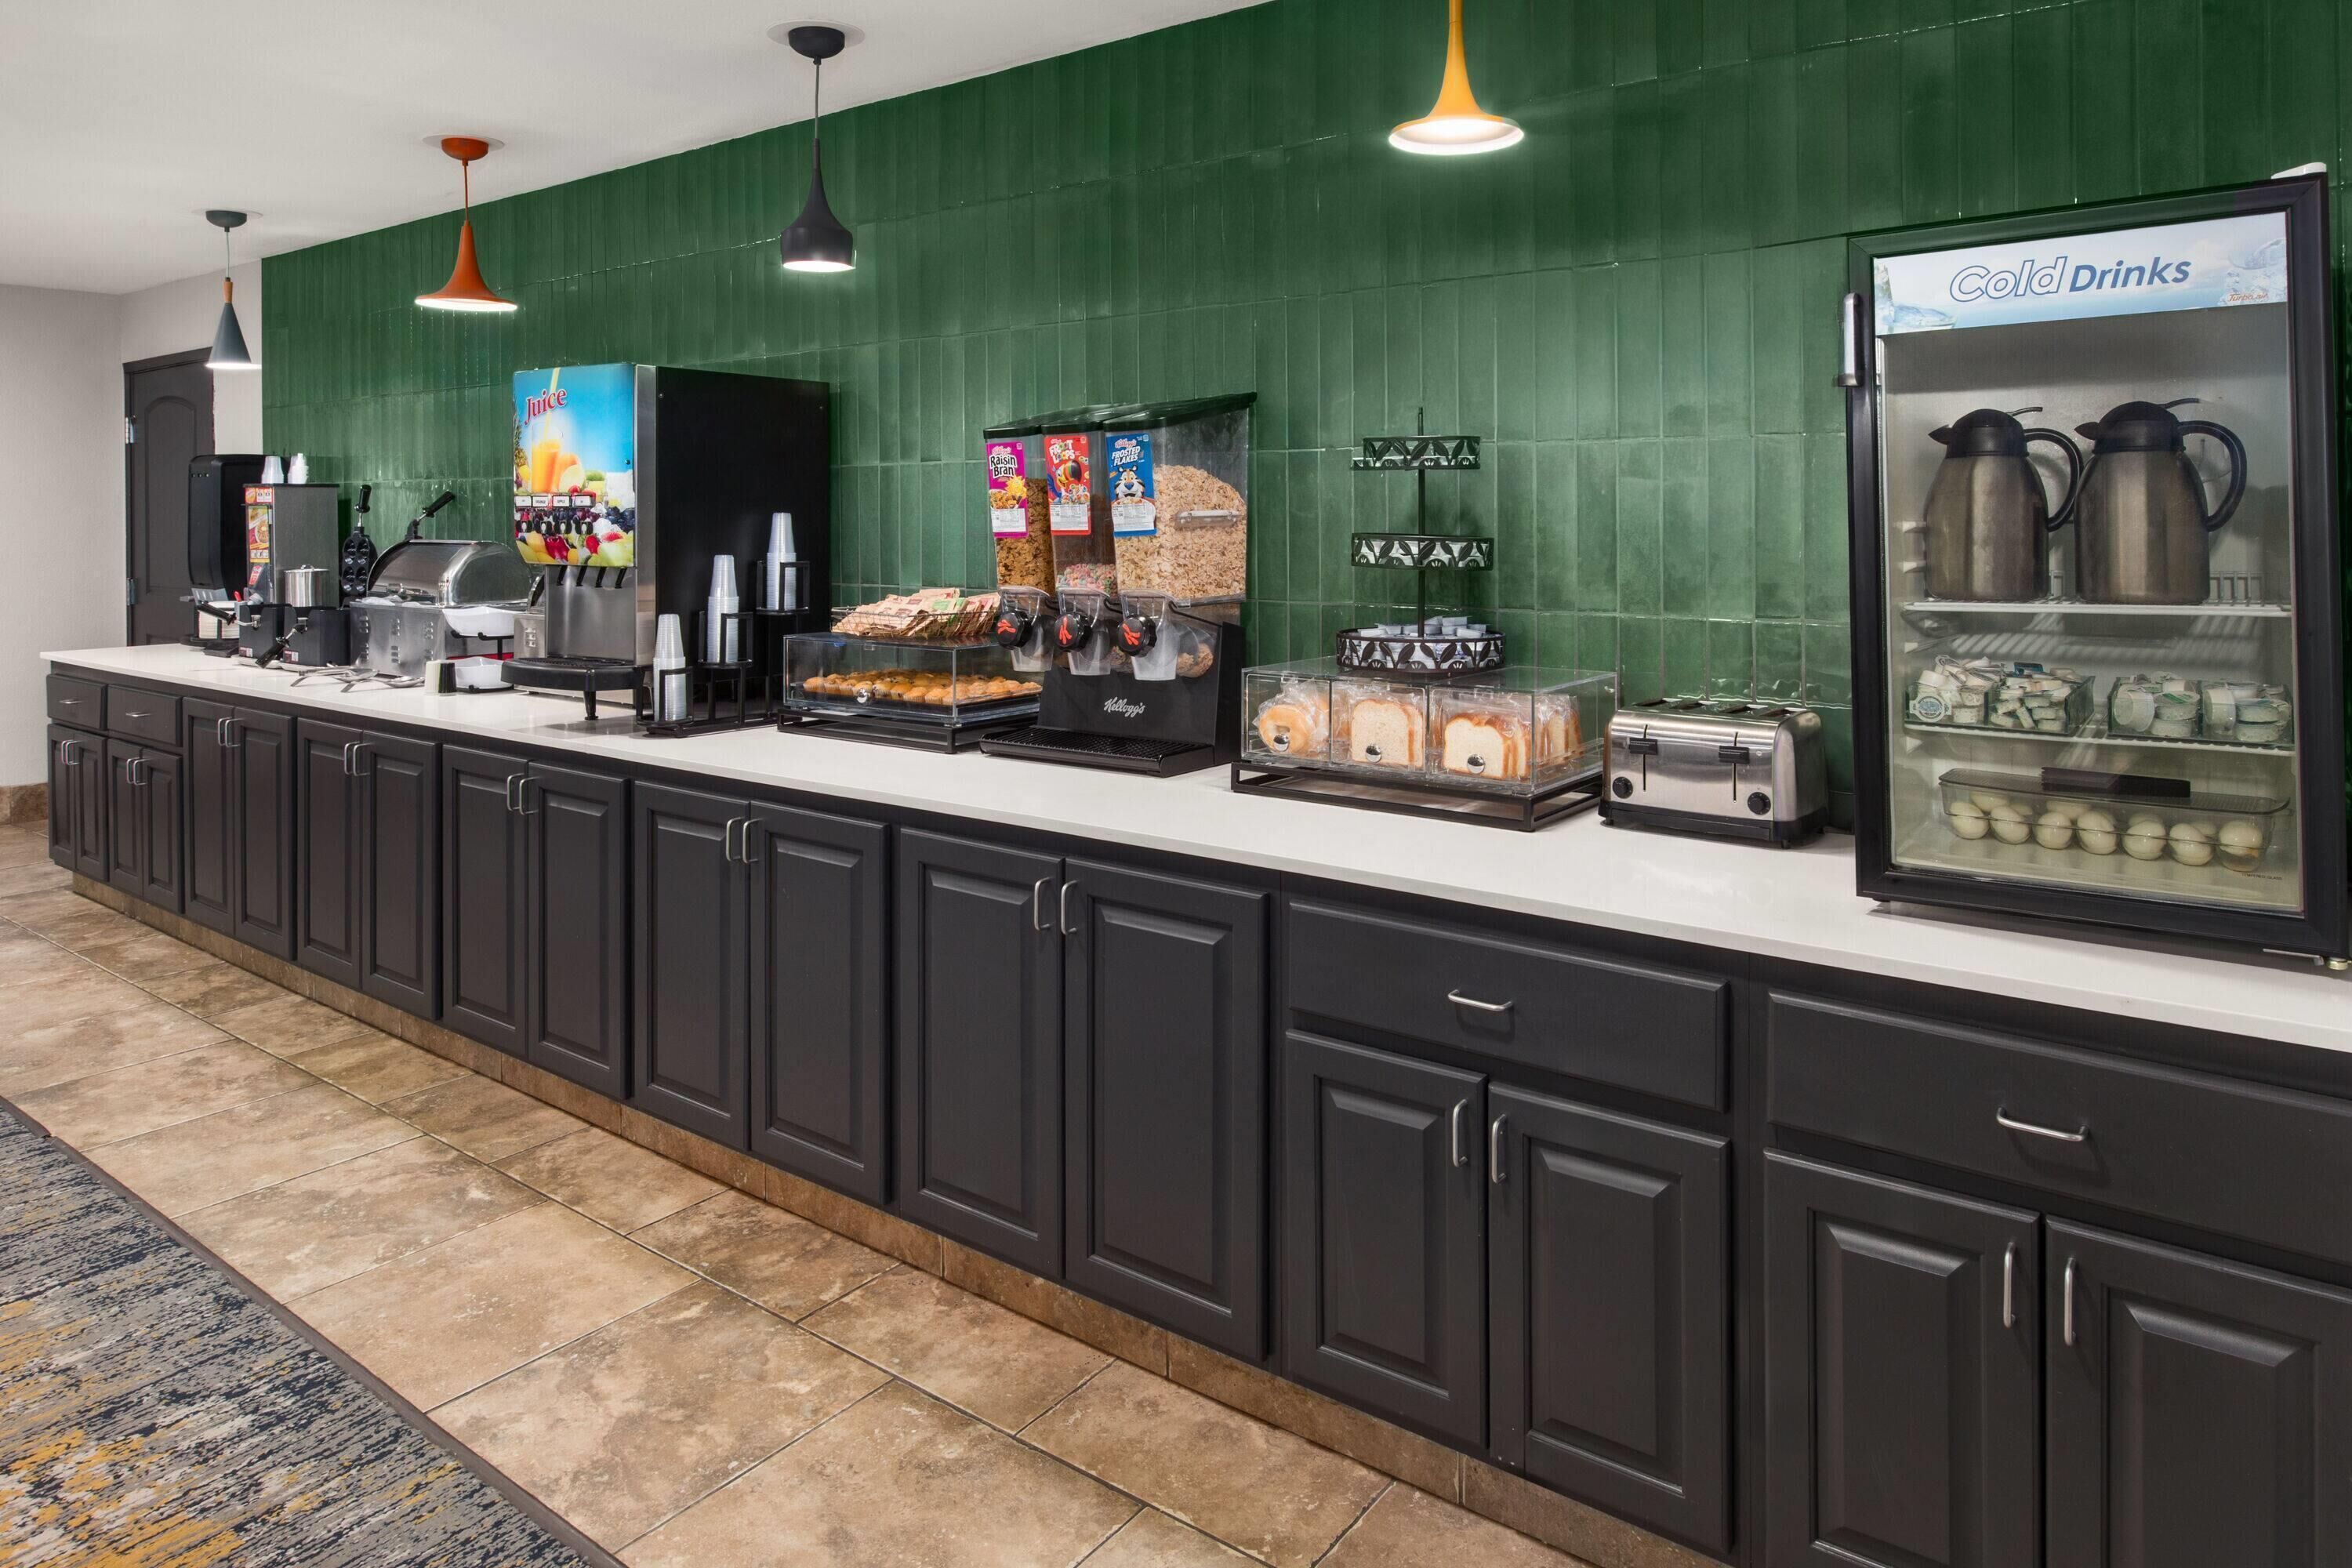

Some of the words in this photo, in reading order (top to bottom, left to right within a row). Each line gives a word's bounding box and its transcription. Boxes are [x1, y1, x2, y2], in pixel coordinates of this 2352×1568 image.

[1950, 256, 2068, 303] Cold
[2069, 256, 2192, 292] Drinks
[524, 389, 567, 425] Juice
[1049, 439, 1073, 457] FROOT
[1112, 446, 1141, 459] FROSTED
[989, 455, 1017, 469] Raisin
[1052, 449, 1075, 464] LOOPS
[1113, 454, 1138, 466] FLAKES
[993, 466, 1015, 477] Bran
[1103, 696, 1146, 717] Kellogg's
